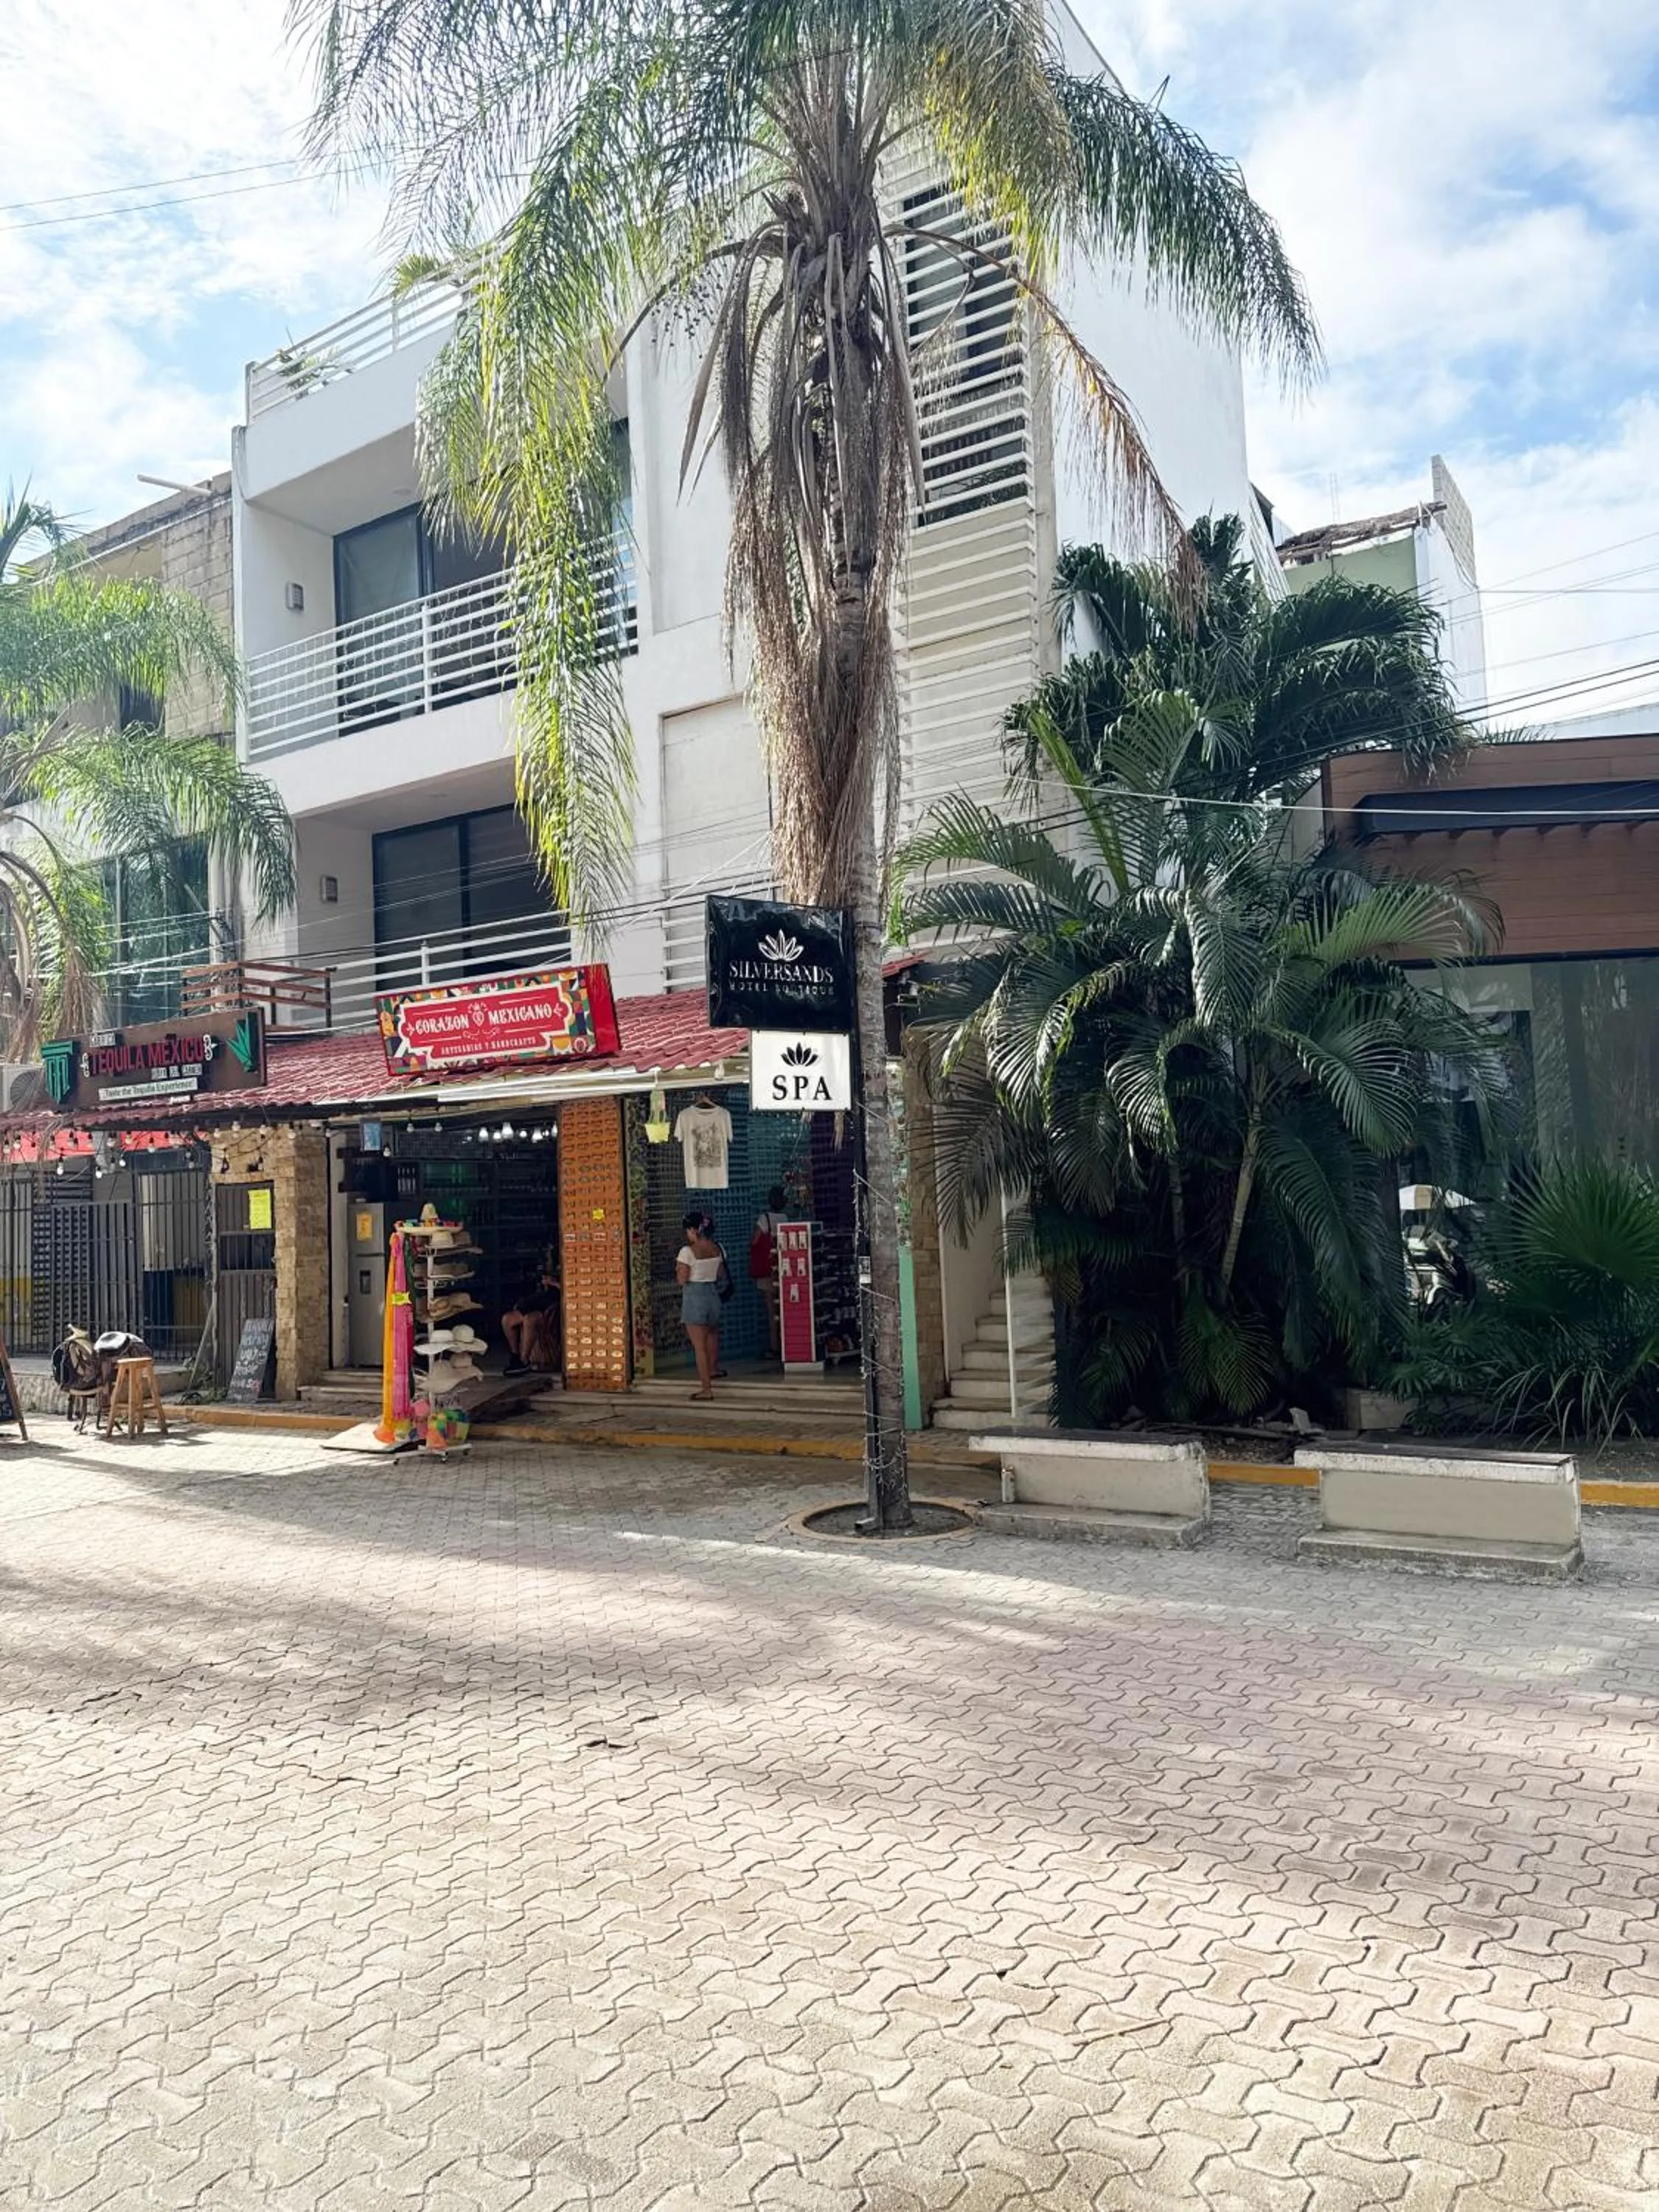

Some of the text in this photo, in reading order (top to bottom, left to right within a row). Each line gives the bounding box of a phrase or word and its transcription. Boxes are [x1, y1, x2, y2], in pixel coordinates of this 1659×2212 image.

[729, 961, 834, 983] SILVERSANDS
[729, 980, 768, 992] HOTEL
[415, 1003, 553, 1034] CORAZON MEXICANO
[90, 1043, 145, 1074] TEQUILA
[772, 1074, 832, 1101] SPA
